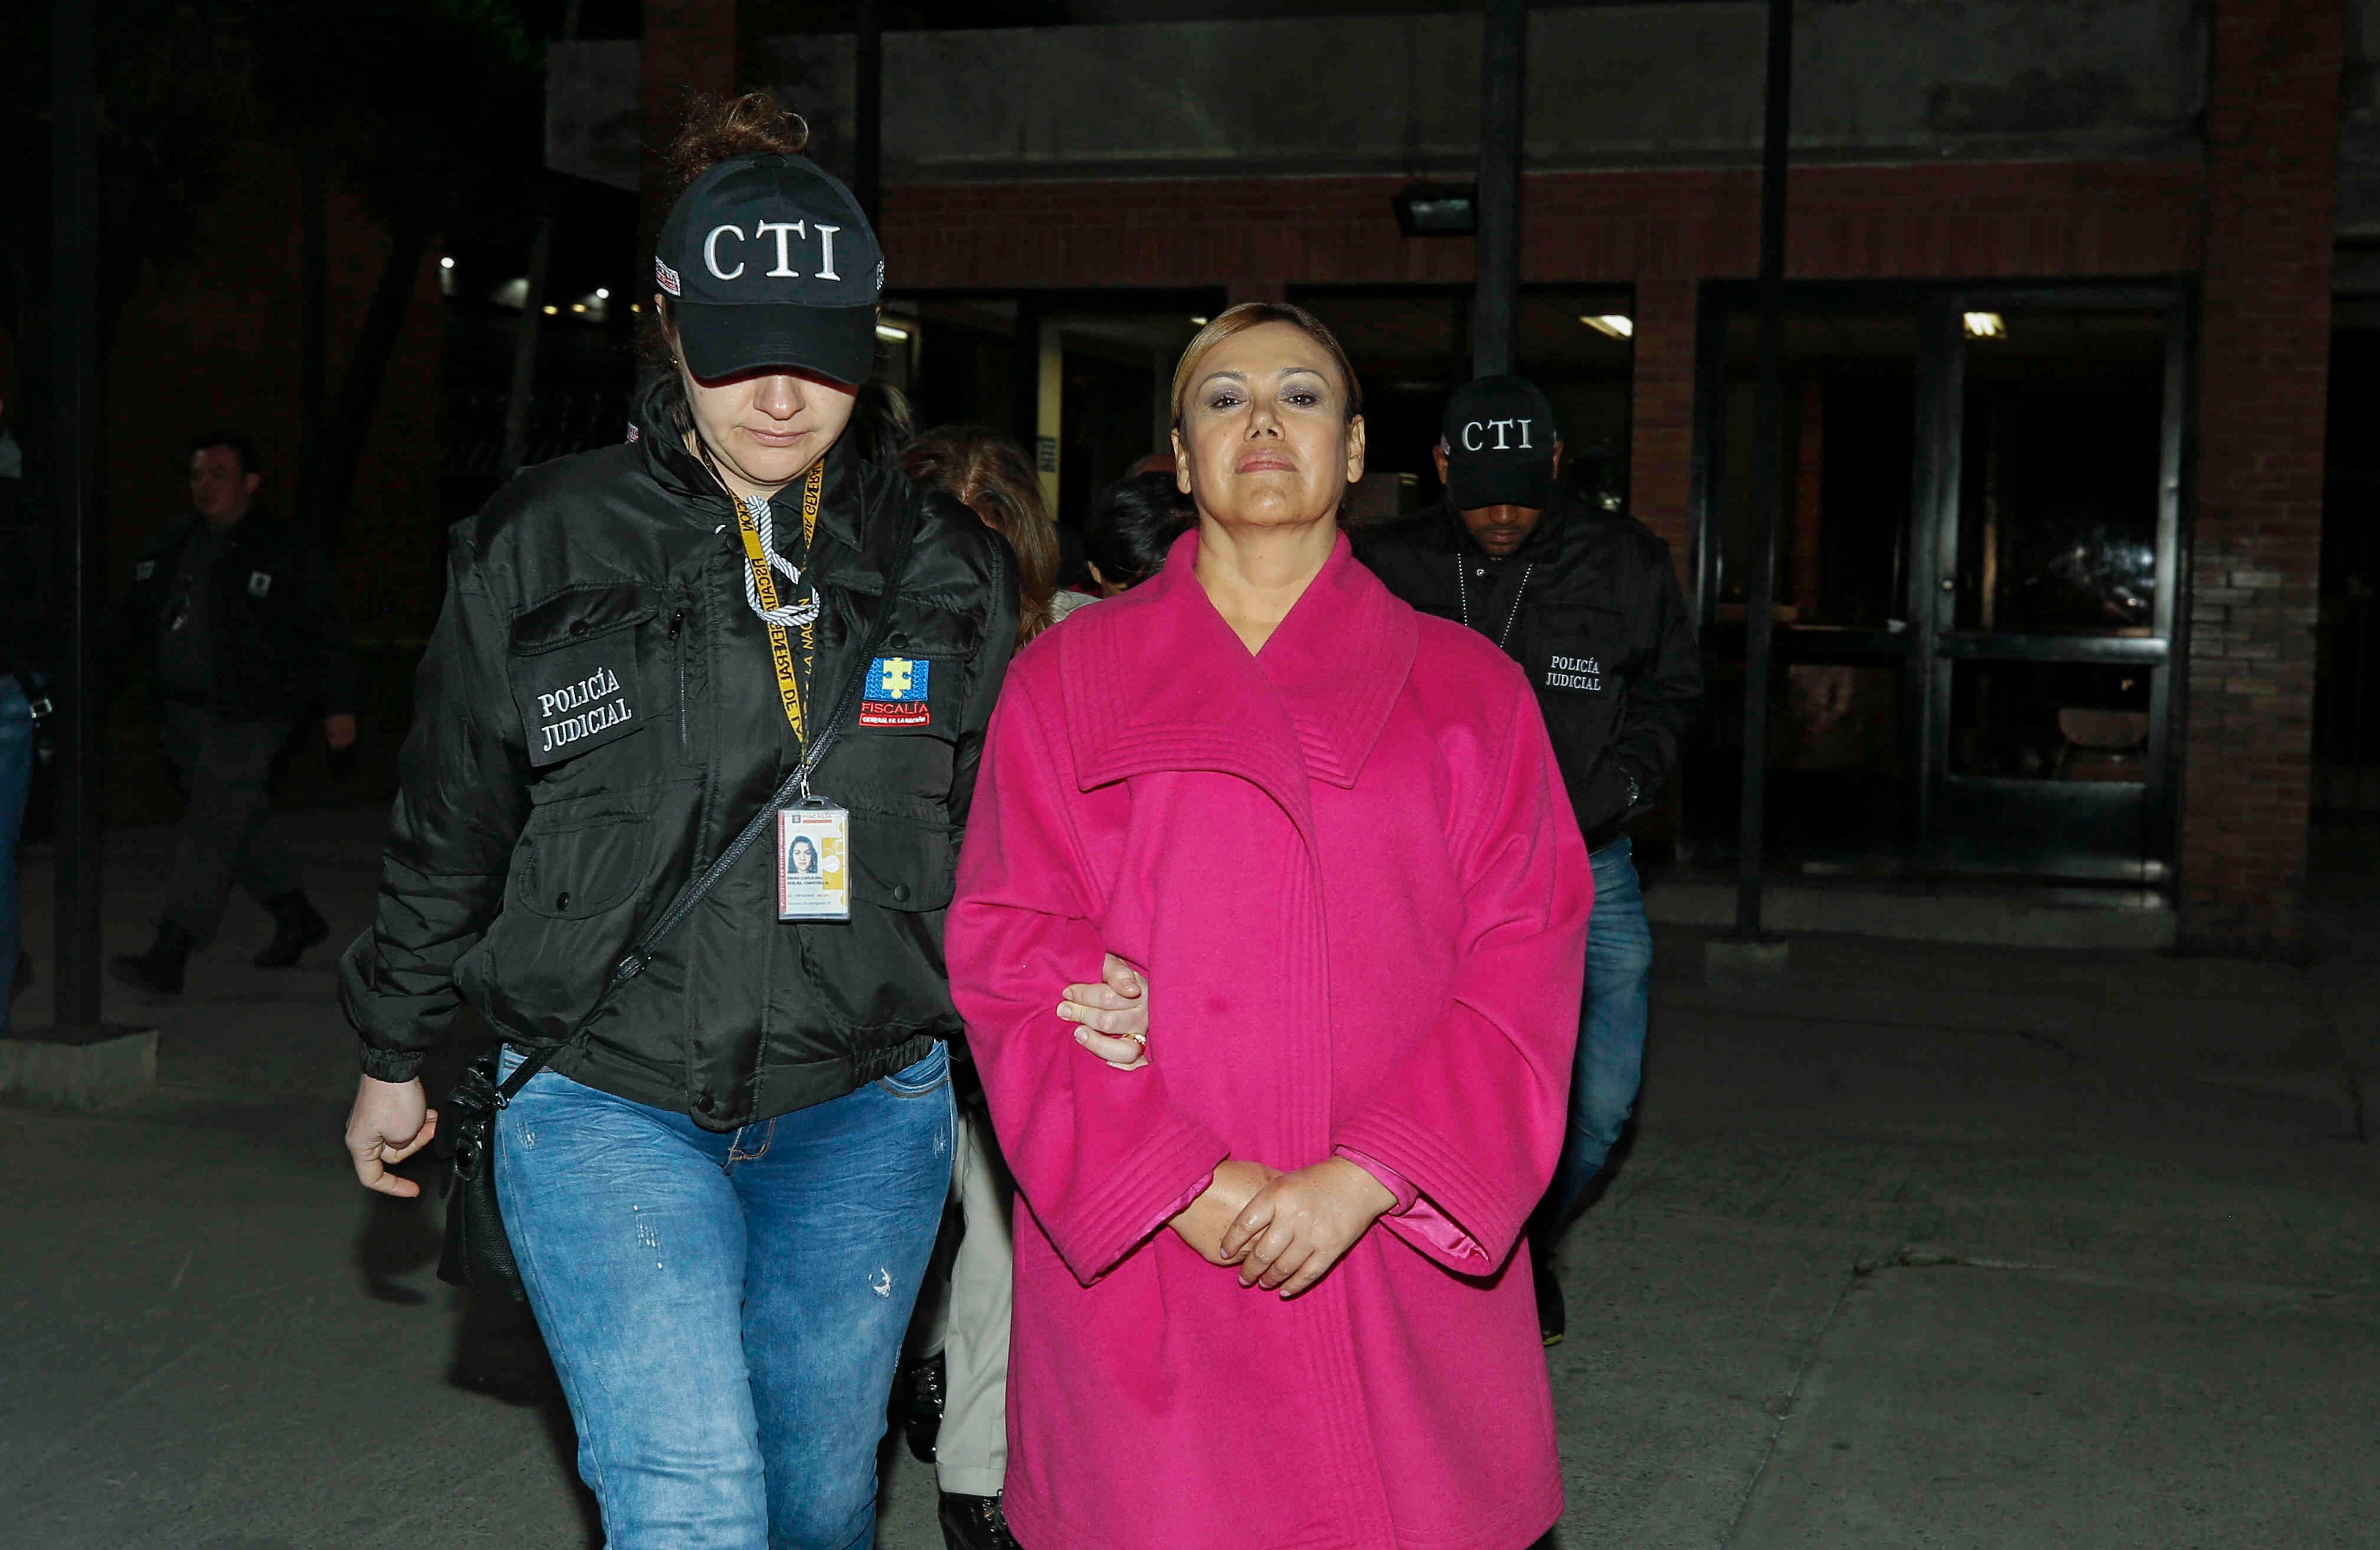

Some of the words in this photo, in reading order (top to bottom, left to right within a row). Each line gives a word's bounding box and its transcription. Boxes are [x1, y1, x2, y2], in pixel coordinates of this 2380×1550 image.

[703, 219, 841, 281] CTI
[1462, 418, 1533, 451] CTI
[1546, 672, 1600, 691] JUDICIAL
[1551, 656, 1600, 673] POLICÍA
[537, 667, 620, 717] POLICÍA
[541, 698, 632, 751] JUDICIAL
